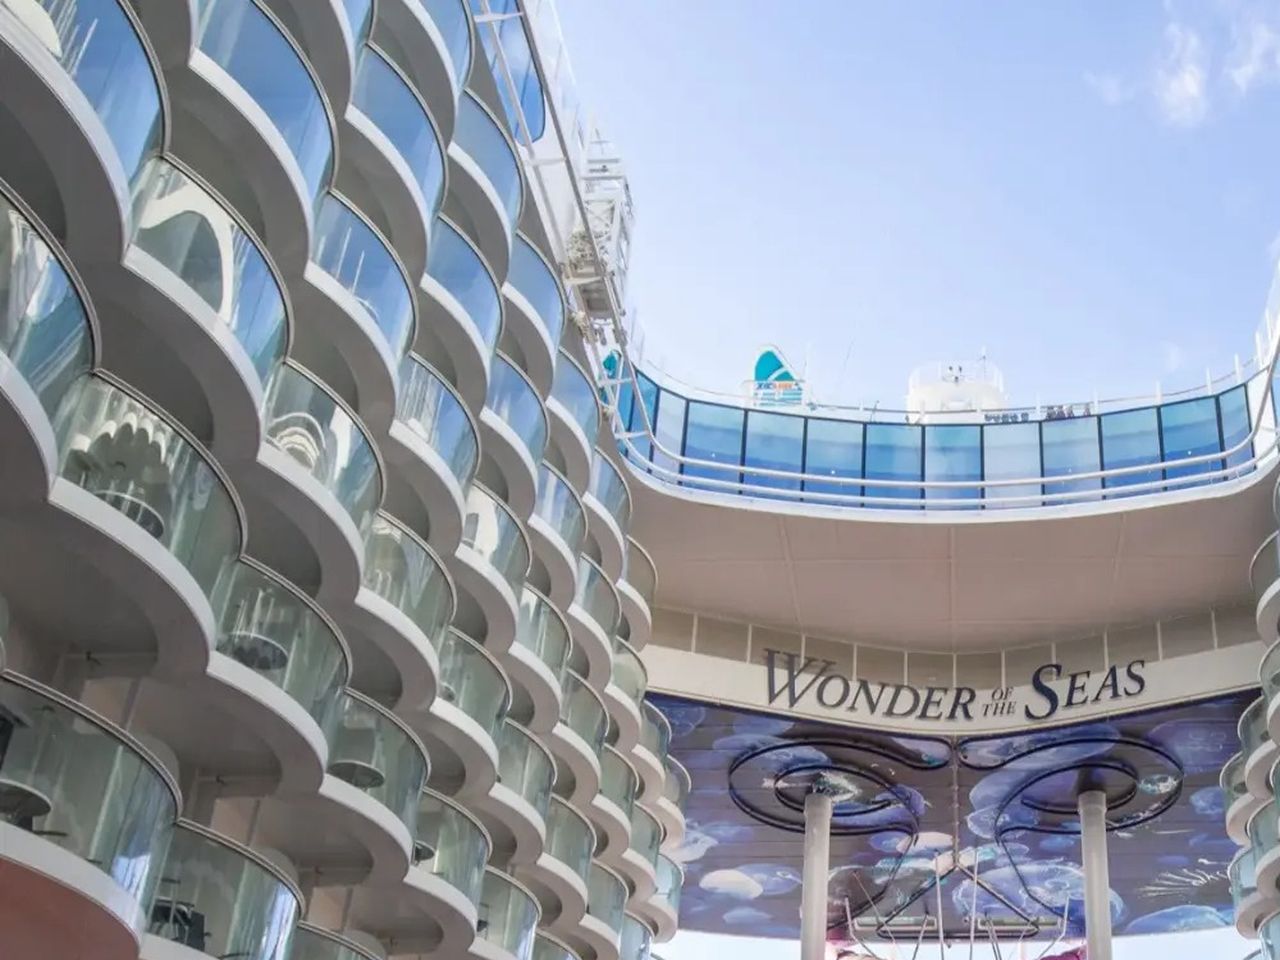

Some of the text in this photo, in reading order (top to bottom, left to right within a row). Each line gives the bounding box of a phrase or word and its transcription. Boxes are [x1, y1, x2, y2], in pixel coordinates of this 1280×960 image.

[763, 648, 1146, 721] WONDER OF THE SEAS
